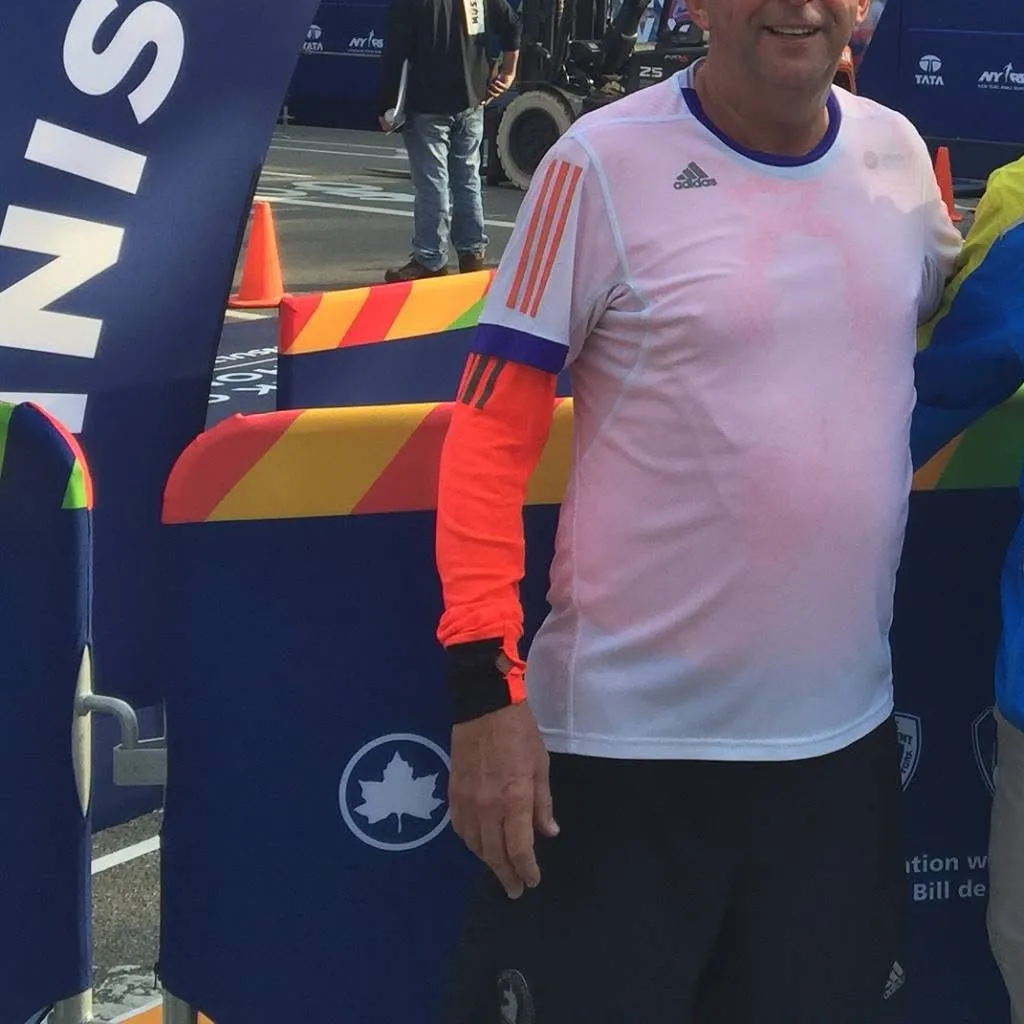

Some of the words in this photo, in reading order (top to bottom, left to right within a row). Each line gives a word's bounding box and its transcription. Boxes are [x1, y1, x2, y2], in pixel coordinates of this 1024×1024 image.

[640, 67, 663, 78] 25
[915, 74, 944, 86] TATA
[674, 178, 717, 189] adidas
[914, 882, 950, 901] Bill
[957, 880, 986, 897] de
